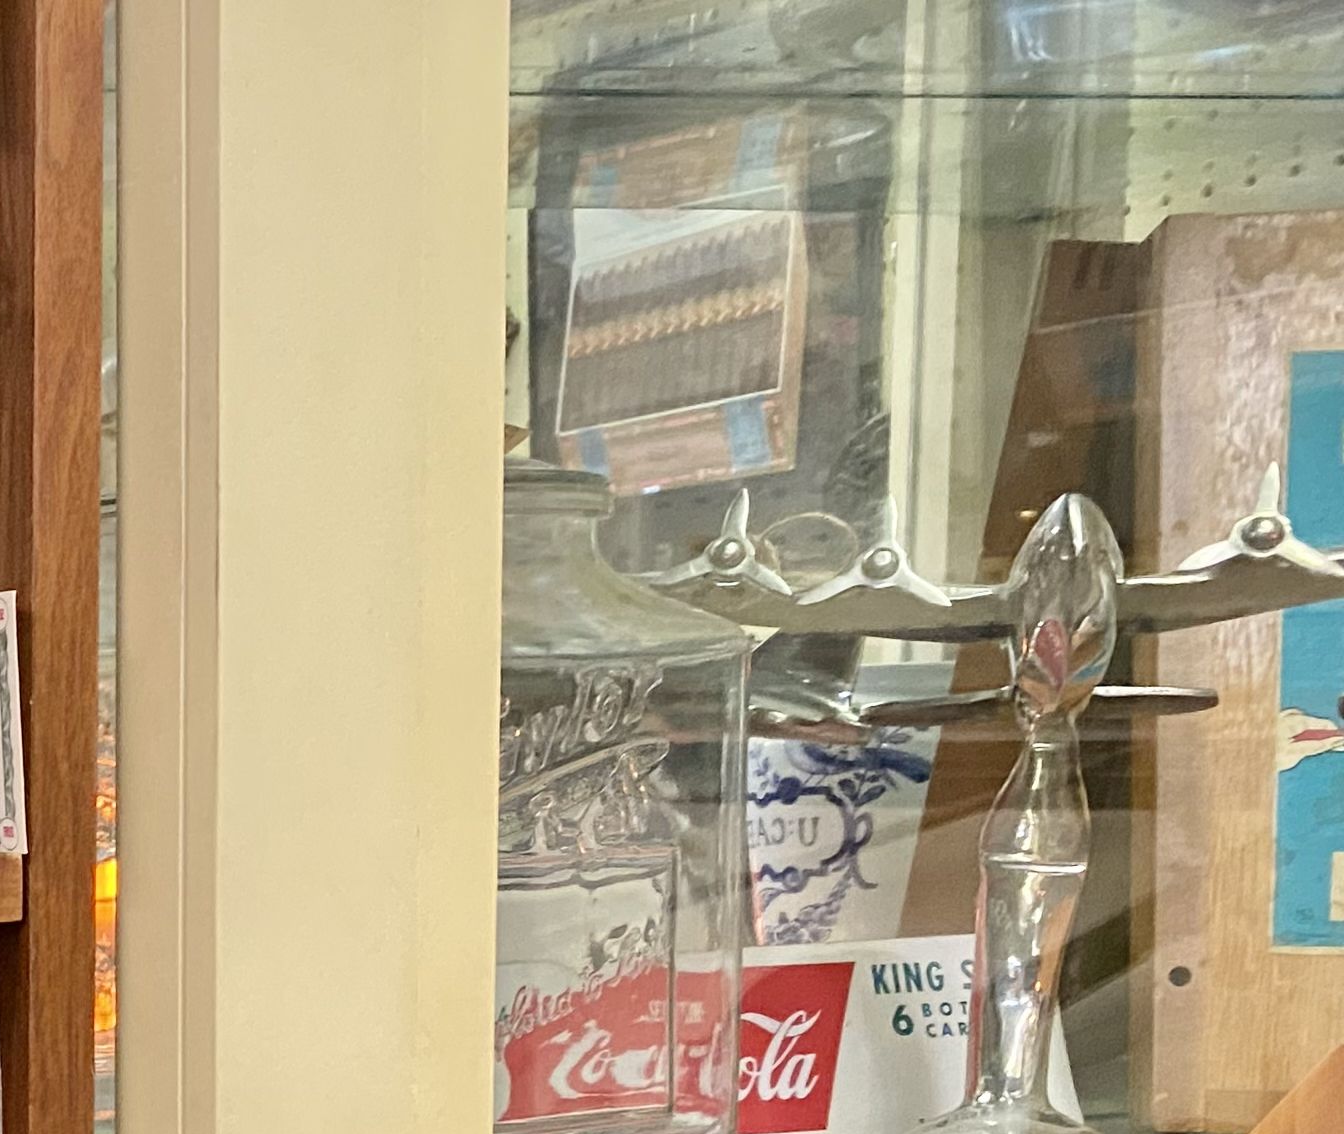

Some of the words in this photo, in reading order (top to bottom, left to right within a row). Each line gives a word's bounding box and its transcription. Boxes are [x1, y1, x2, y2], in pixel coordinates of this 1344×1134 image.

[870, 960, 944, 995] KING
[891, 1004, 915, 1037] 6
[921, 1001, 969, 1018] BOT
